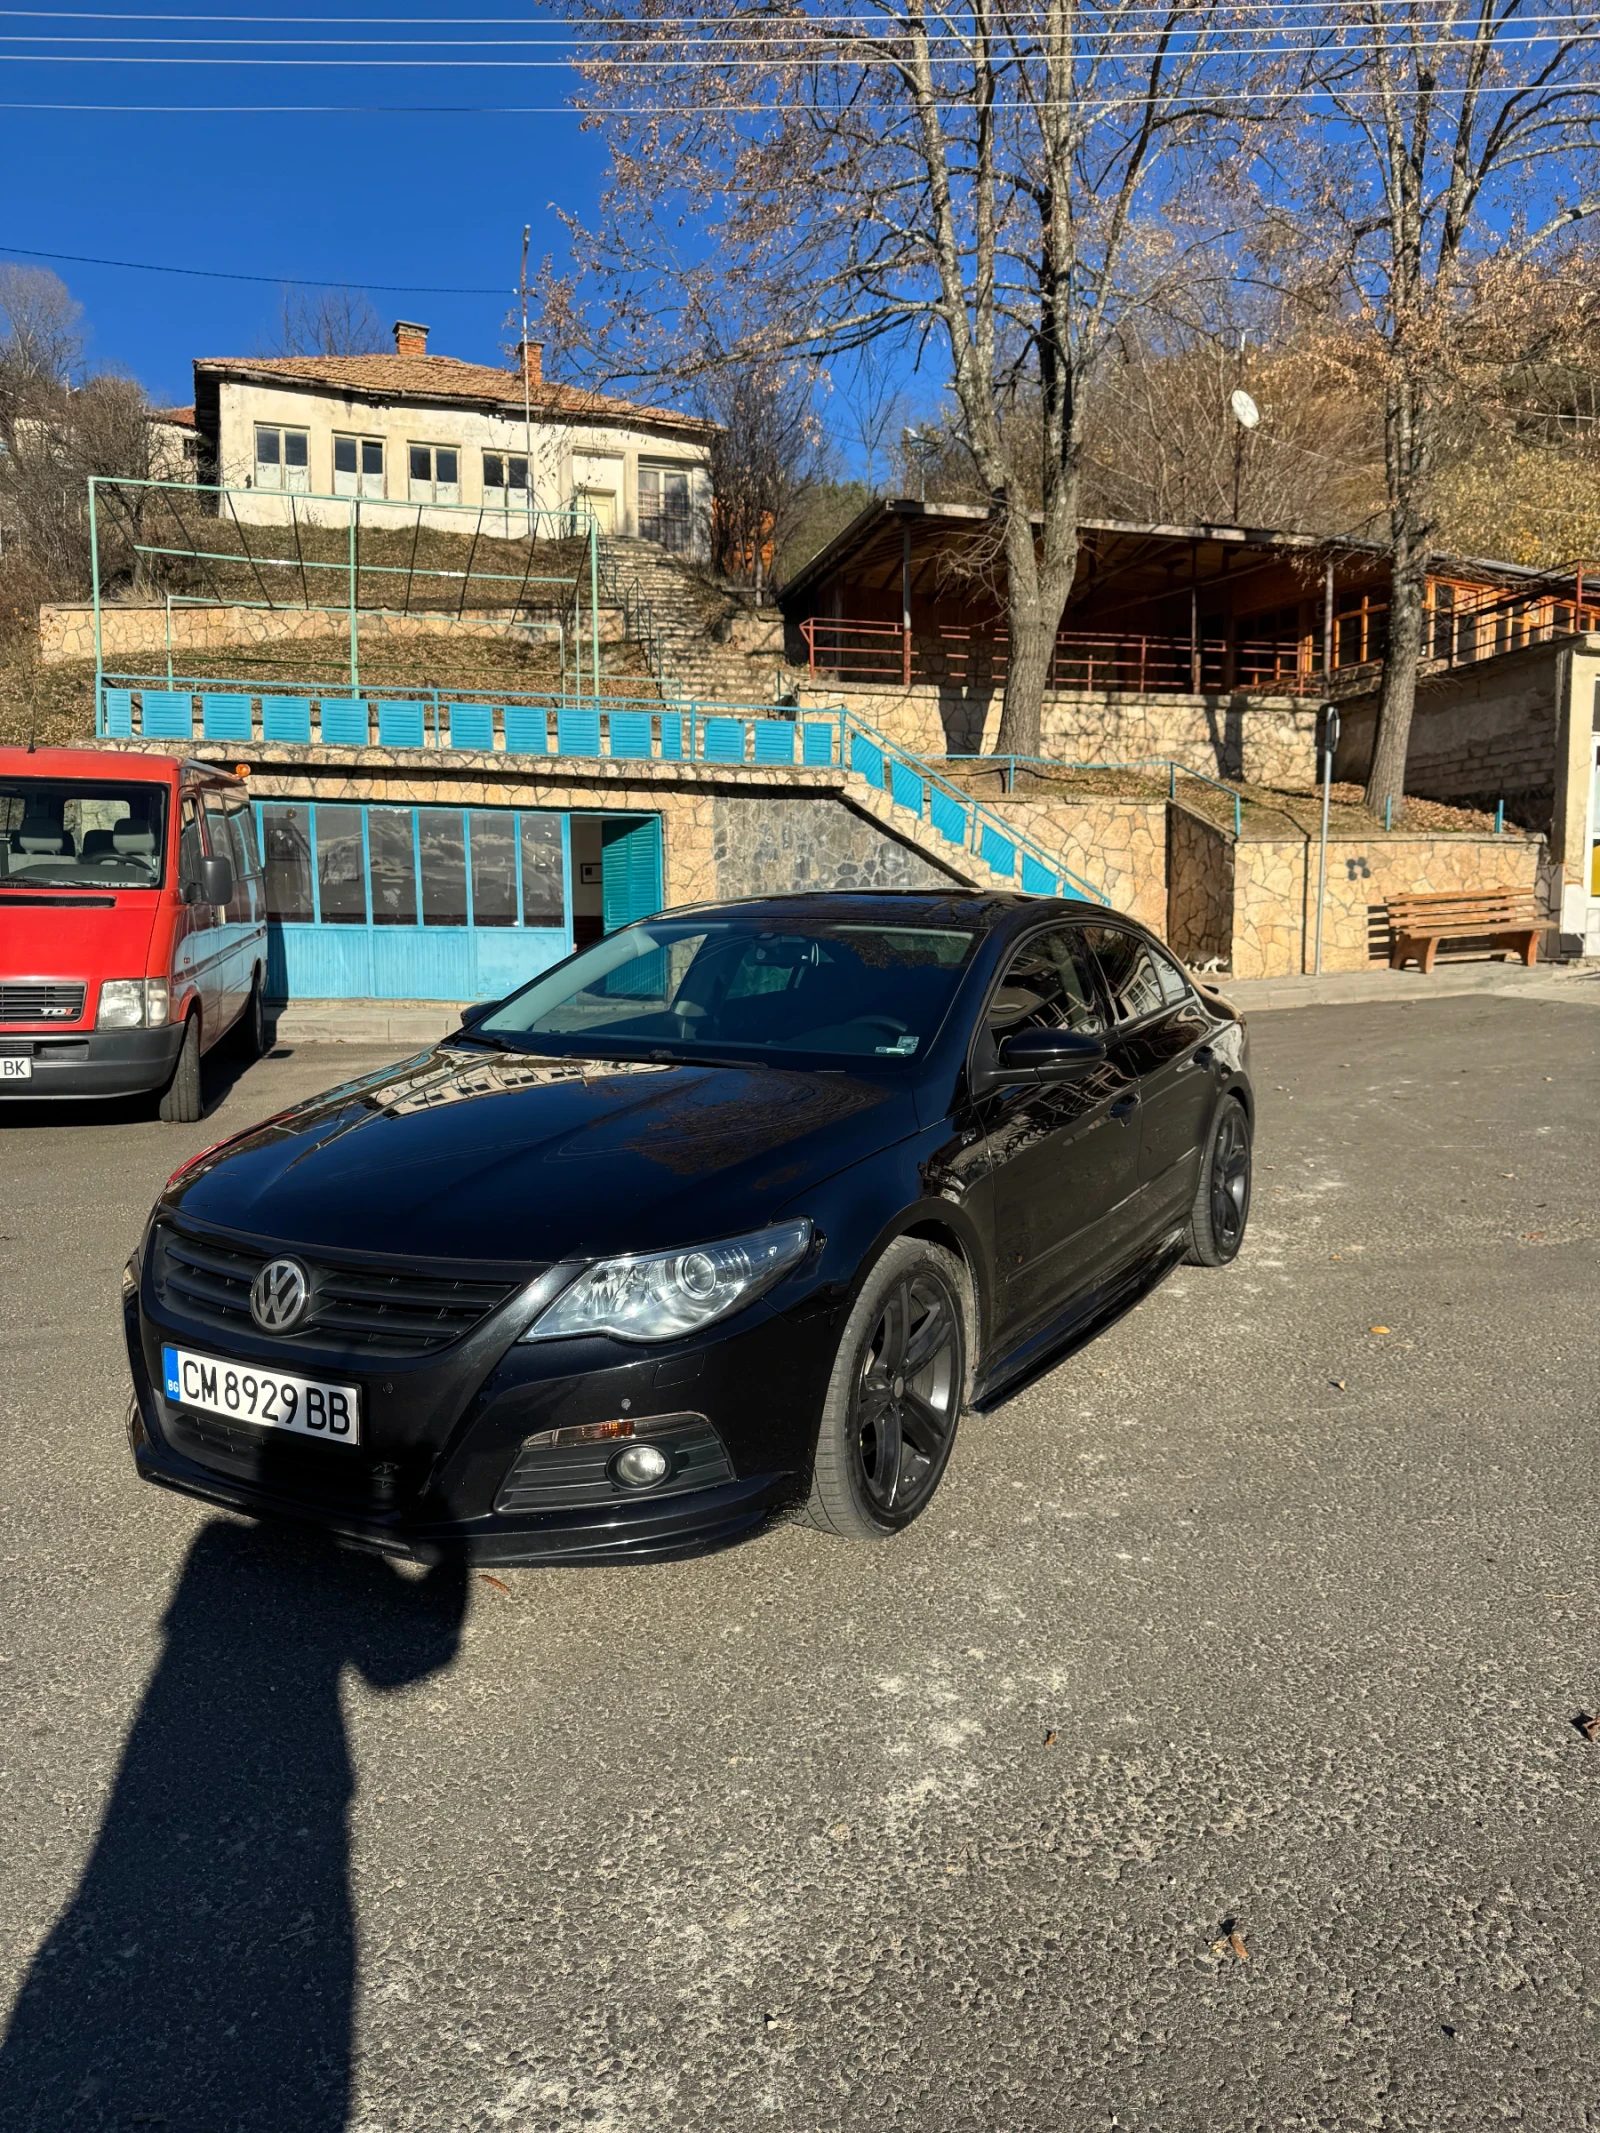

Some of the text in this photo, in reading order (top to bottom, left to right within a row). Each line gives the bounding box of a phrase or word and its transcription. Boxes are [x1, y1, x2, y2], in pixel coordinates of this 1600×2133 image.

[41, 1008, 73, 1016] TDI
[4, 1060, 26, 1076] BK
[252, 1260, 305, 1330] VW
[168, 1380, 179, 1393] BG
[183, 1360, 350, 1435] CM 8929 BB
